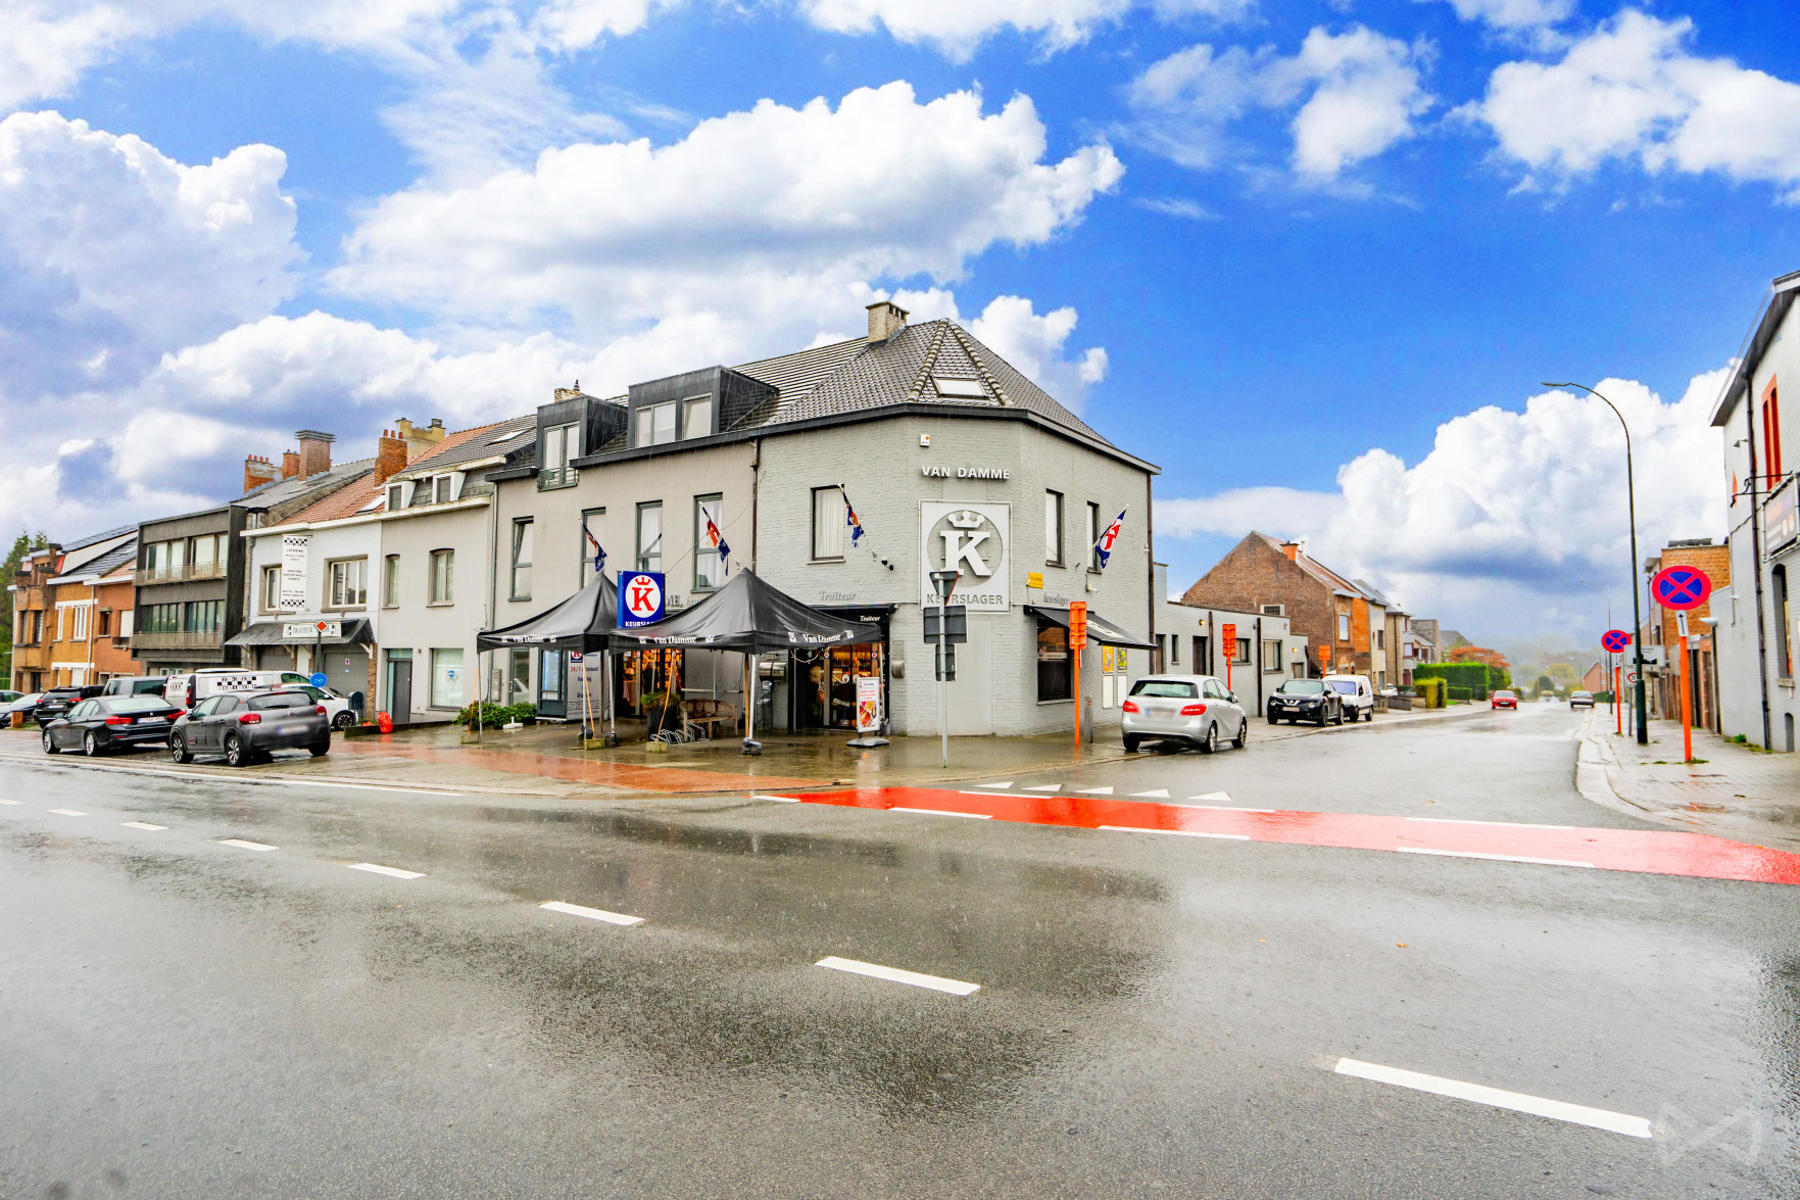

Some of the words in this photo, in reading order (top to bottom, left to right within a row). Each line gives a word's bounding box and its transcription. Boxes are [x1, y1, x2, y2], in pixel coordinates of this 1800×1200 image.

[921, 465, 950, 477] VAN
[957, 467, 1010, 480] DAMME
[940, 530, 992, 577] K
[631, 587, 655, 612] K
[819, 591, 857, 601] Traiteur
[926, 593, 1003, 605] KERSLAGER
[803, 633, 818, 644] Van
